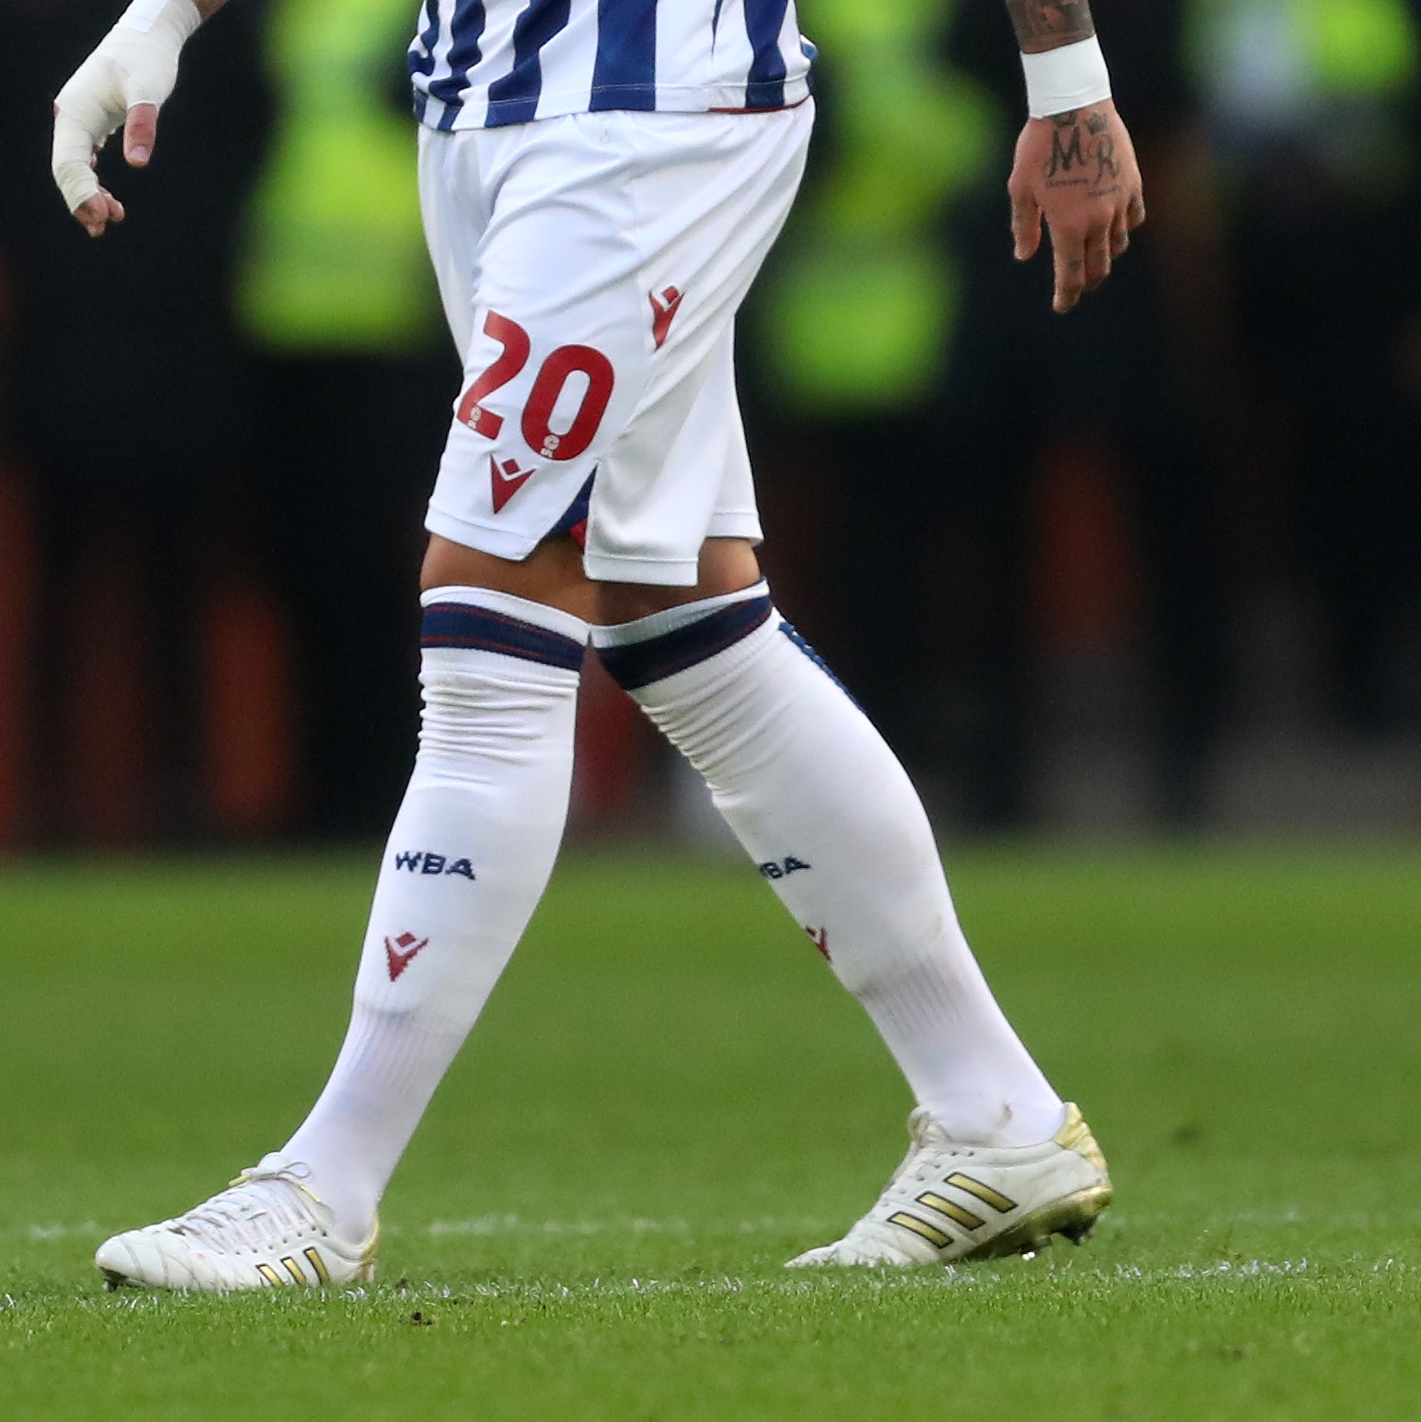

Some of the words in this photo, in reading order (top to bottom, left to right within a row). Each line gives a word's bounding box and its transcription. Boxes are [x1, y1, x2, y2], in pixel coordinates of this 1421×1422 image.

[456, 309, 615, 461] 20
[395, 851, 476, 880] WBA
[759, 856, 811, 879] BA
